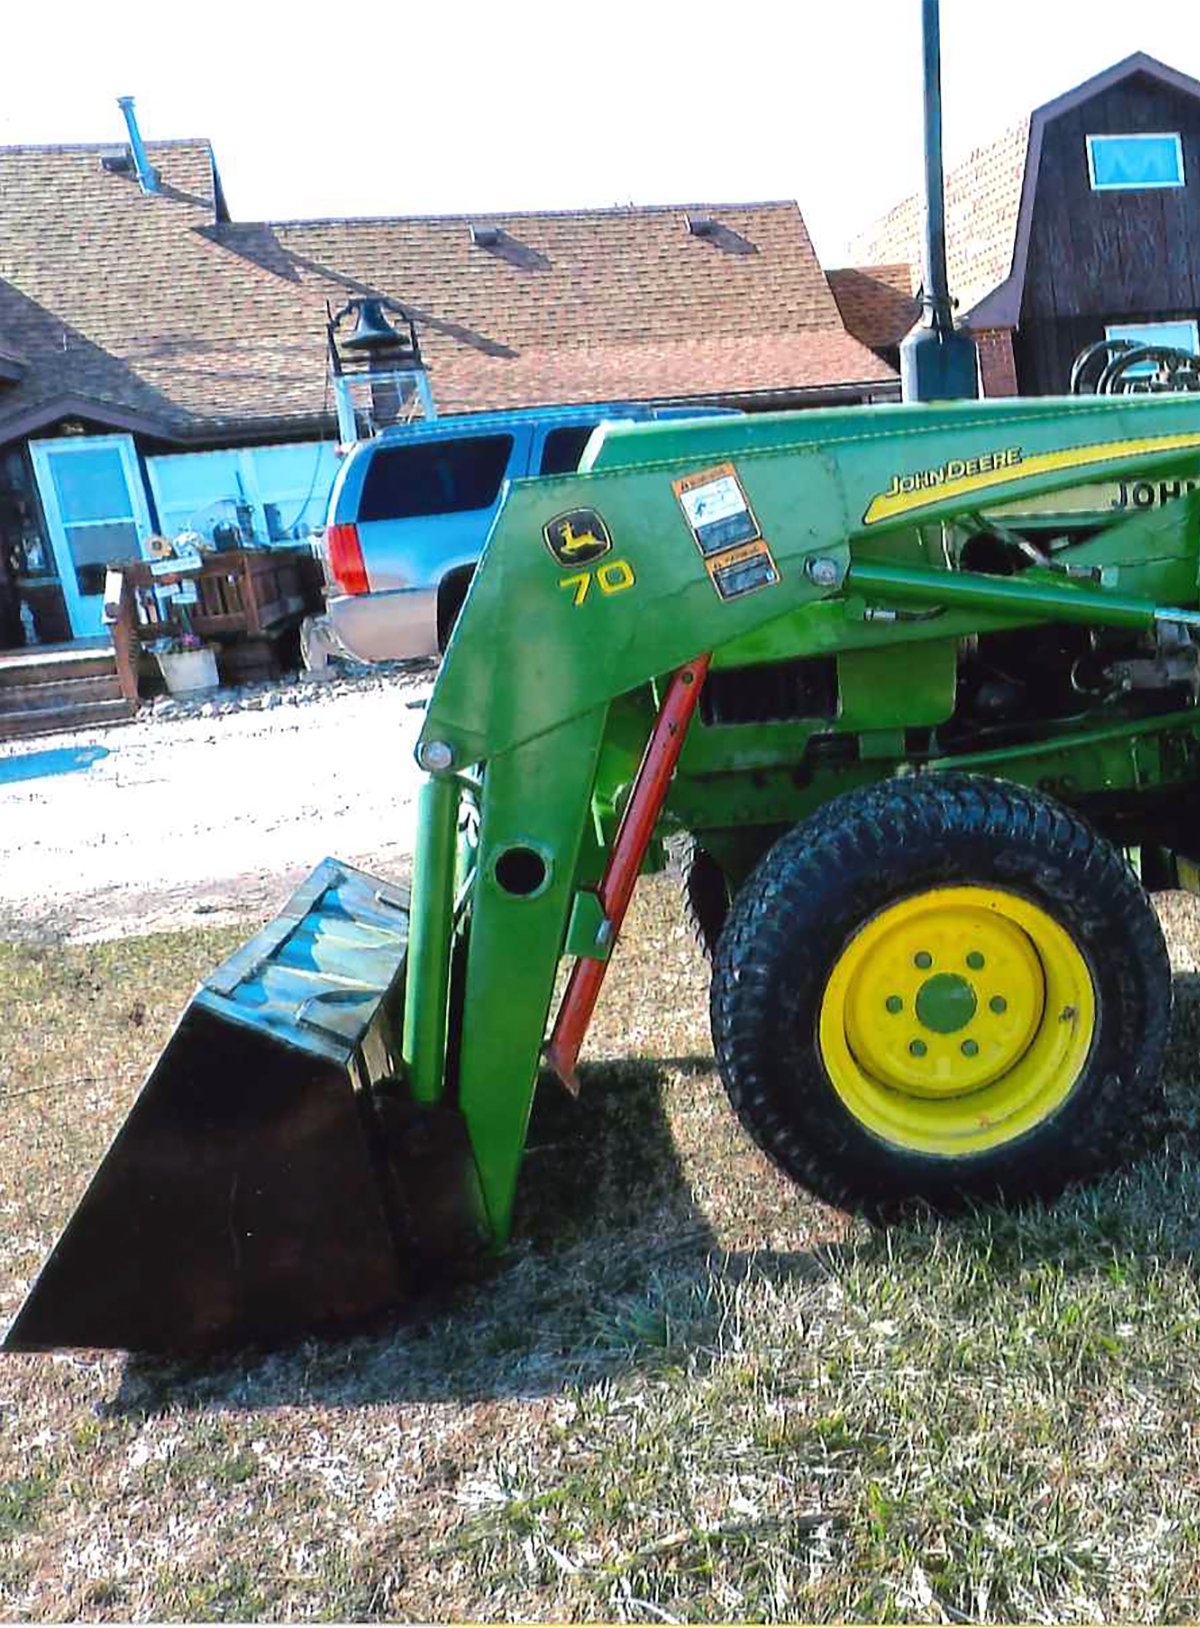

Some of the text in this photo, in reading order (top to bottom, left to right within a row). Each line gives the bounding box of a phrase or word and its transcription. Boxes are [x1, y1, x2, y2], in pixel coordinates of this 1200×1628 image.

[885, 447, 1023, 498] JOHN DEERE
[559, 561, 636, 605] 70
